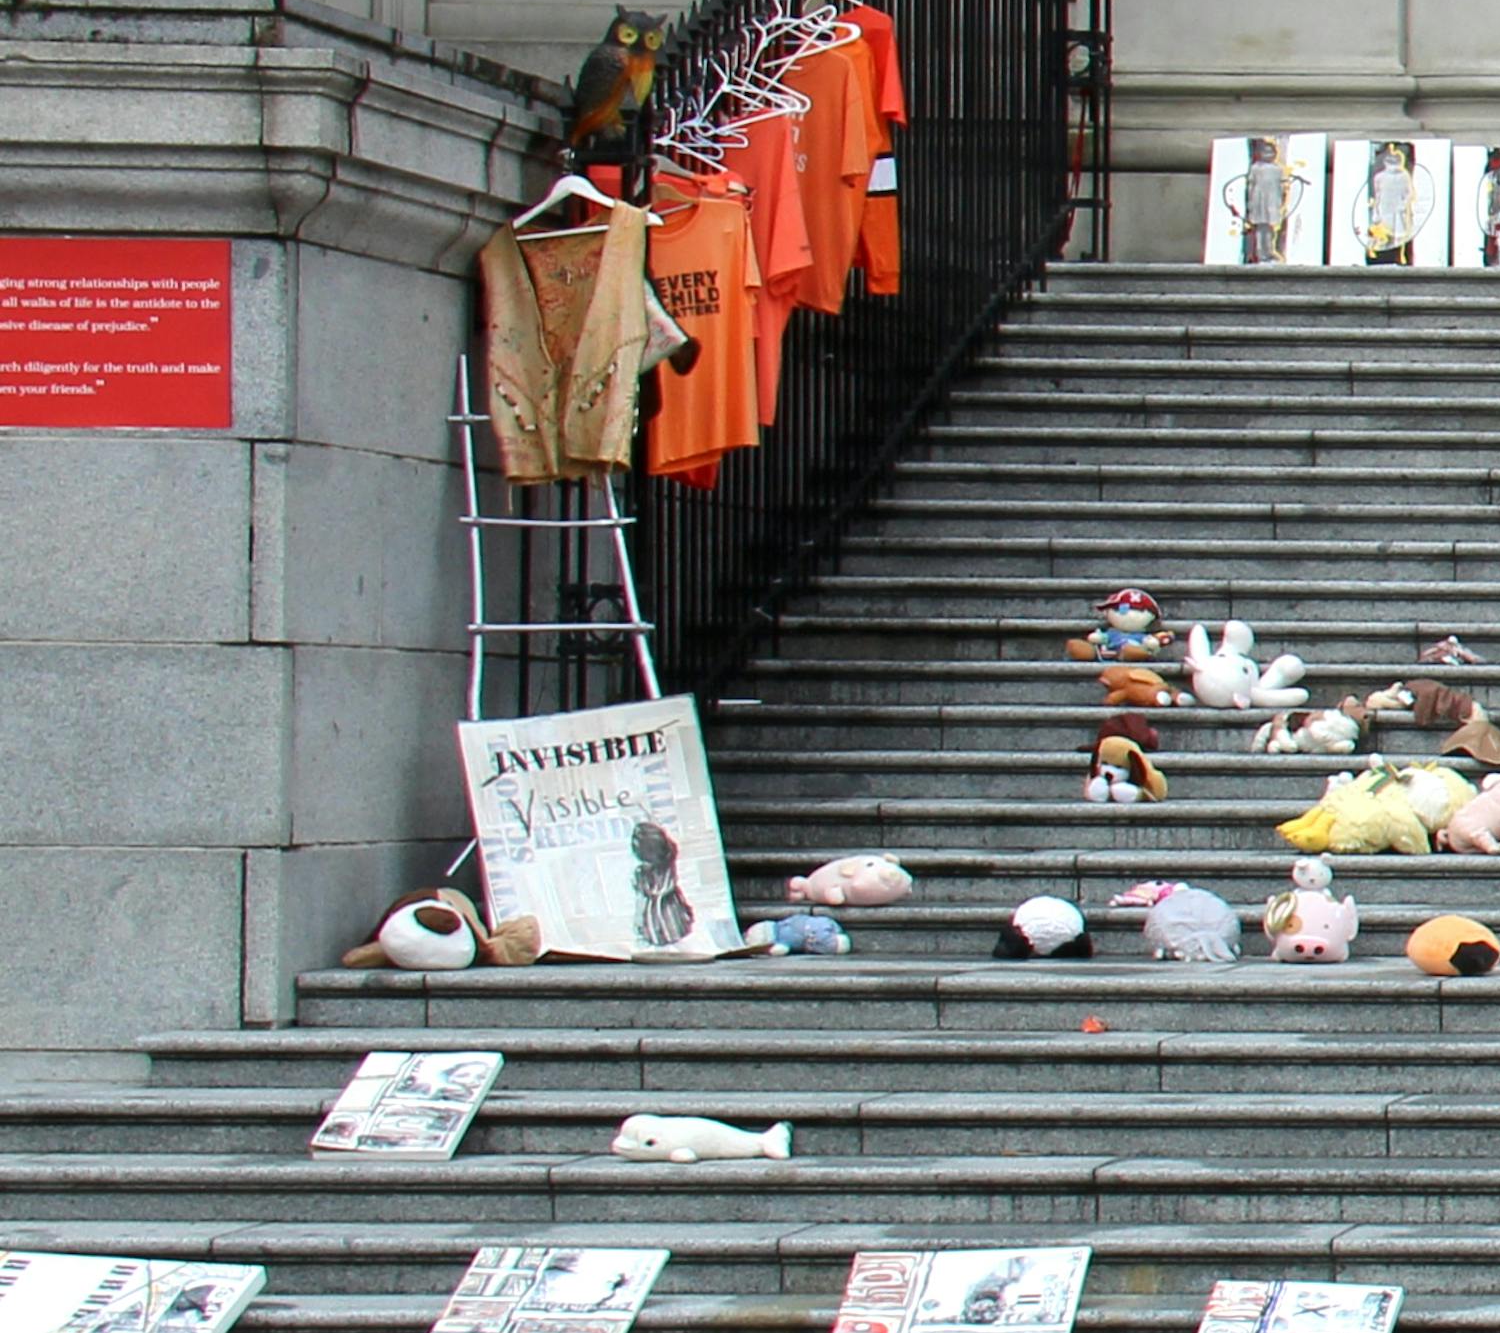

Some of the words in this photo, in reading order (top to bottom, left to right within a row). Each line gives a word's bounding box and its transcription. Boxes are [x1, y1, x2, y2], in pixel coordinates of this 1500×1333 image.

[27, 278, 67, 290] strong
[70, 278, 149, 291] relationships
[152, 278, 179, 289] with
[181, 278, 220, 292] people
[656, 270, 718, 289] EVERY
[2, 296, 18, 308] all
[21, 296, 57, 308] walks
[59, 297, 72, 308] of
[74, 297, 93, 308] life
[96, 297, 107, 308] is
[110, 298, 129, 309] the
[132, 298, 183, 309] antidote
[185, 299, 198, 309] to
[201, 298, 220, 309] the
[671, 303, 720, 318] ATTERS
[28, 320, 74, 331] disease
[76, 320, 89, 331] of
[24, 361, 80, 375] diligently
[83, 362, 101, 373] for
[103, 362, 123, 374] the
[126, 363, 158, 374] truth
[161, 363, 185, 374] and
[187, 363, 221, 374] make
[19, 385, 48, 397] your
[495, 730, 667, 774] INVISIBLE
